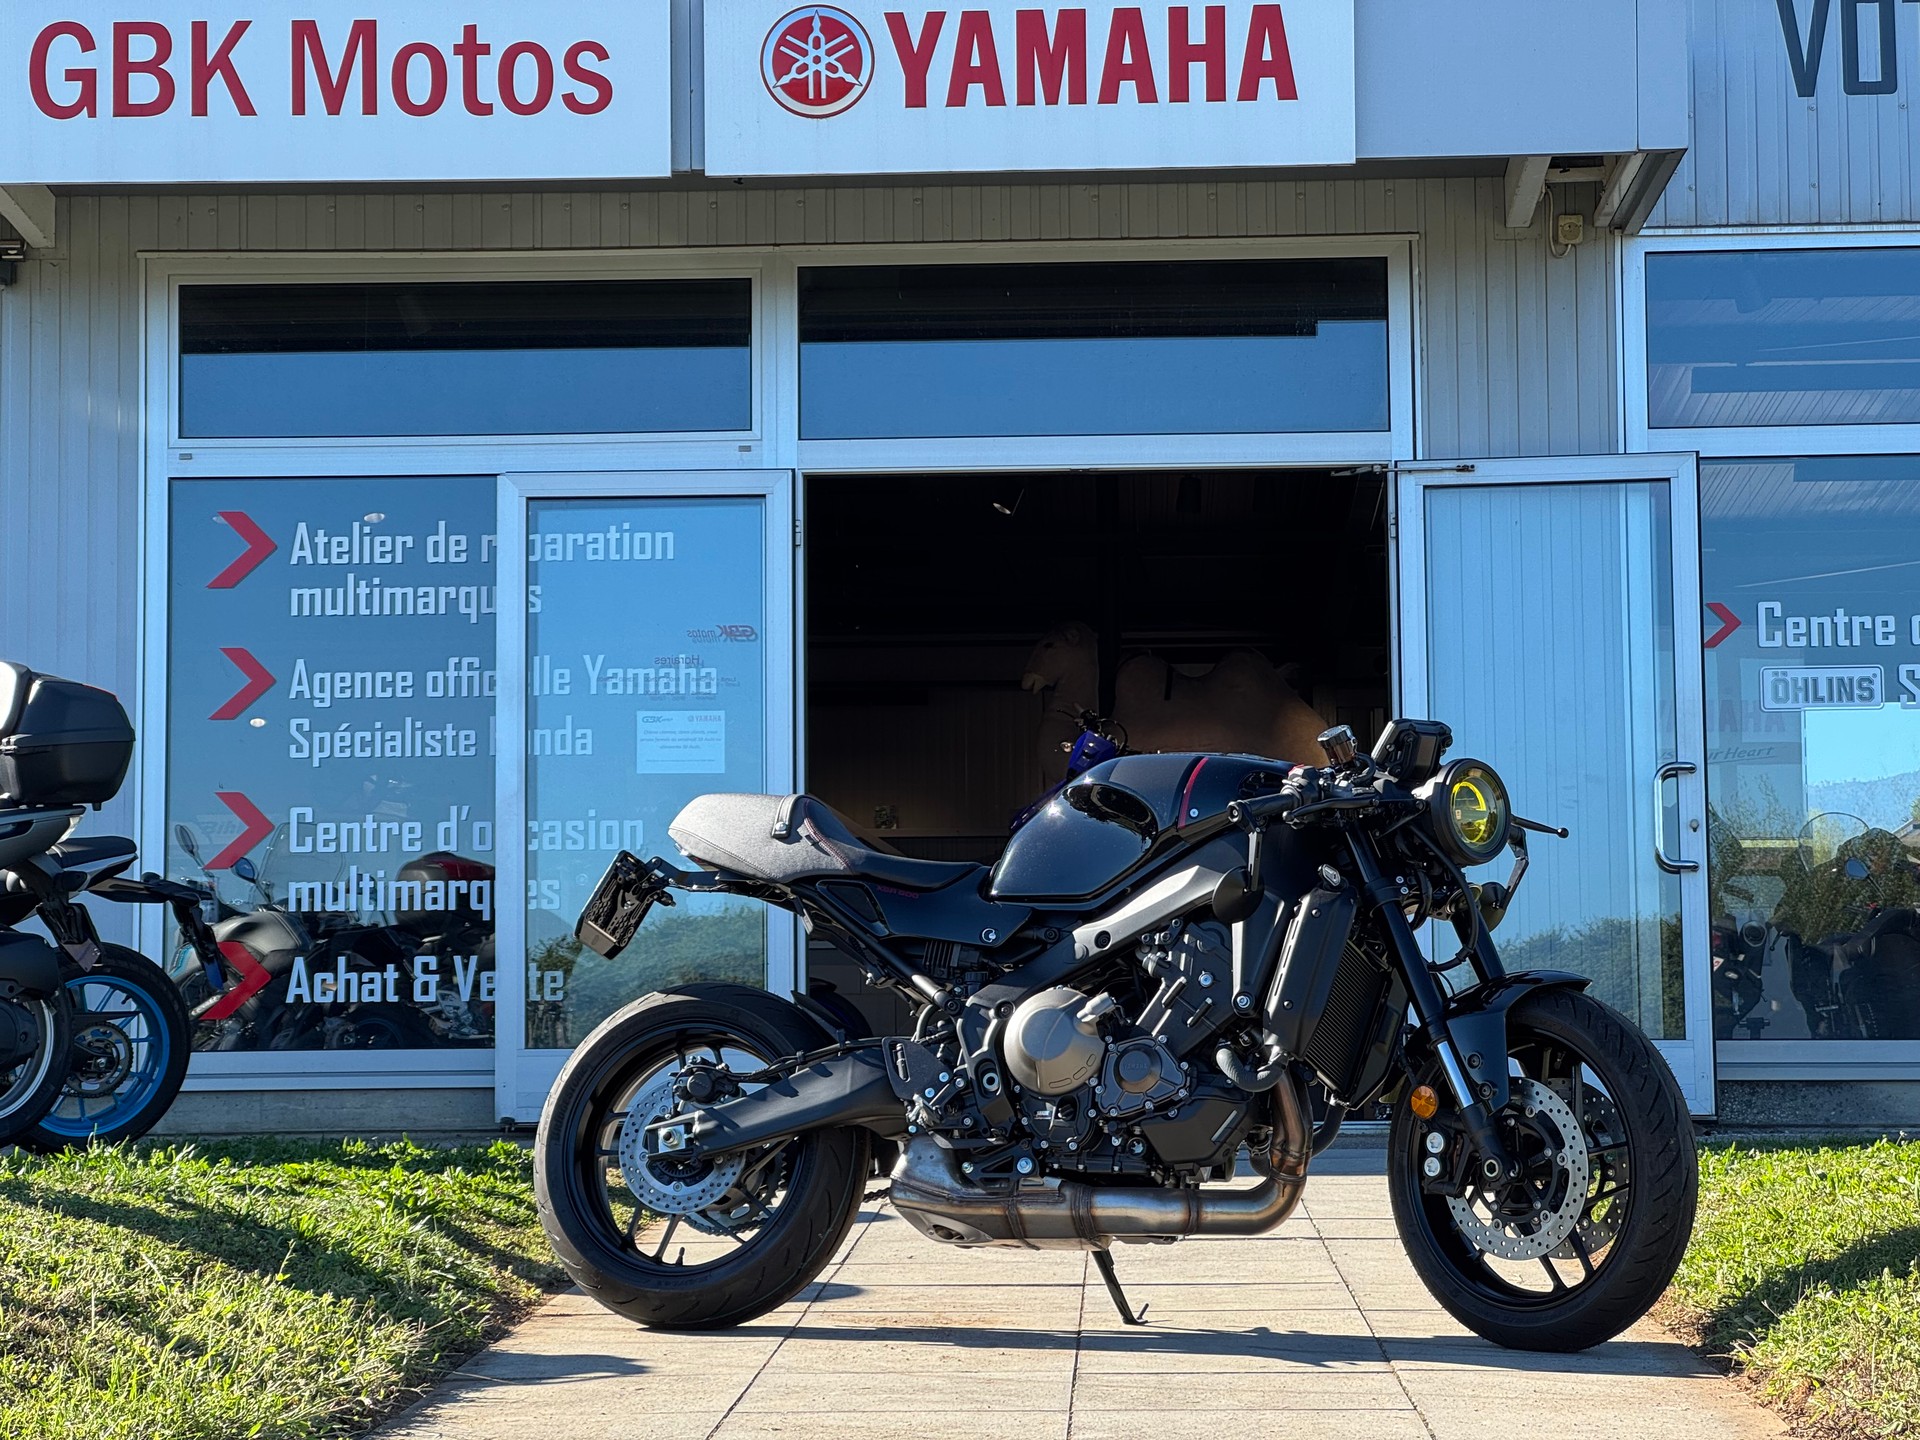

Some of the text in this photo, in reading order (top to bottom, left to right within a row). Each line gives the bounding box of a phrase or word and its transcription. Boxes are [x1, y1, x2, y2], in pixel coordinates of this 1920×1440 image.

[29, 19, 613, 119] GBK Motos
[885, 4, 1298, 108] YAMAHA
[1776, 0, 1920, 97] VO
[290, 521, 675, 564] Atelier de rparation
[289, 573, 542, 624] multimarqus
[1757, 601, 1896, 648] Centre
[289, 653, 717, 708] Agence officlle Yamaha
[288, 714, 593, 767] Spécialiste nda
[289, 805, 644, 854] Centre d'ocasion
[288, 865, 560, 921] multimarqs
[286, 955, 565, 1004] Achat & Vete
